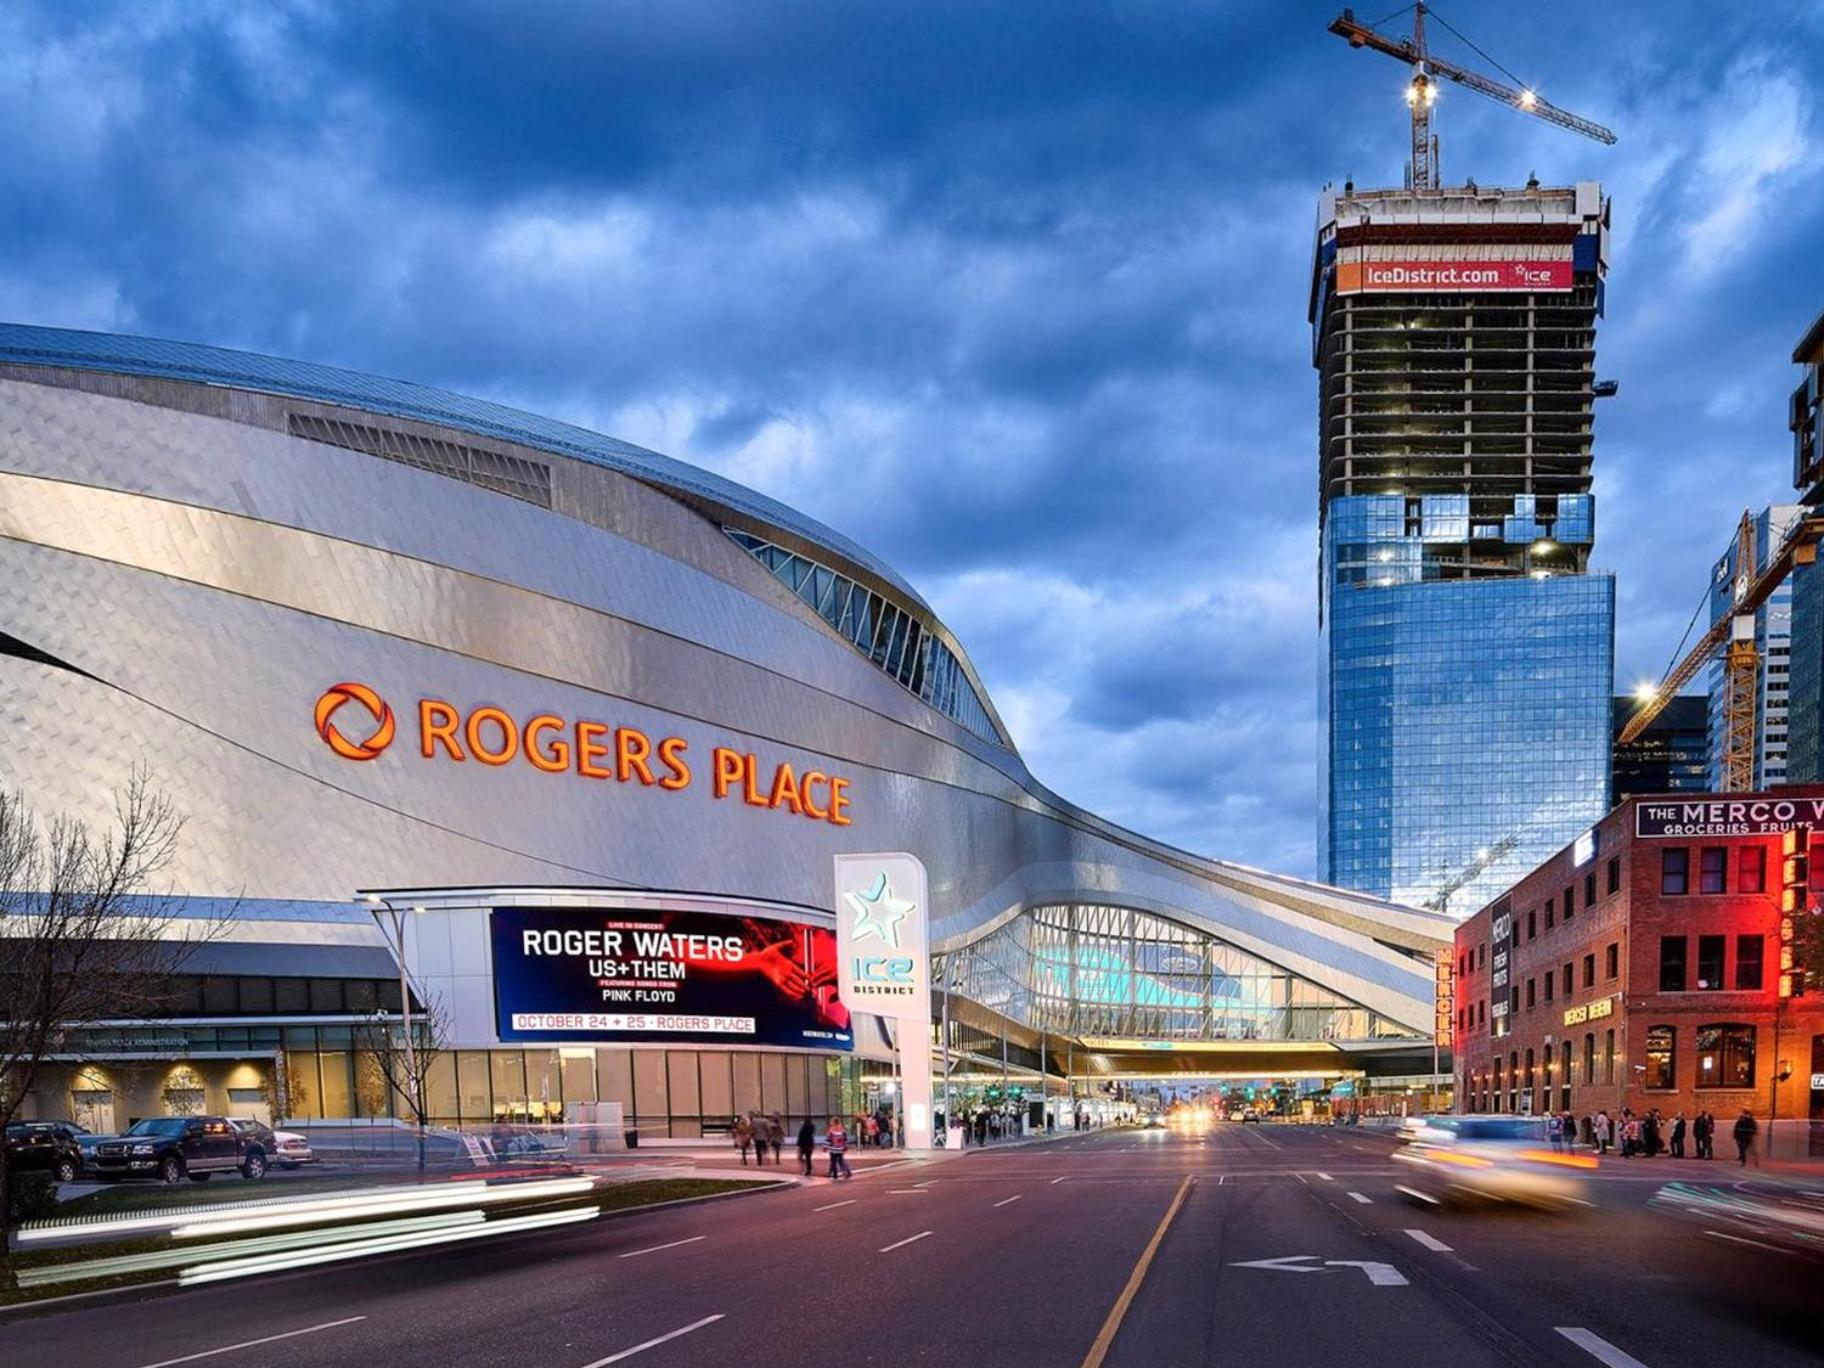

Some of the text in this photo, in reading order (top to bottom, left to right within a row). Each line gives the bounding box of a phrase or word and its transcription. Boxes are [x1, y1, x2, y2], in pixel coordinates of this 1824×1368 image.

[1368, 267, 1499, 284] IceDistrict.com
[418, 698, 852, 825] ROGERS PLACE
[1648, 808, 1676, 820] THE
[1683, 802, 1795, 823] MERCO
[1664, 823, 1750, 835] GROCERIES
[522, 930, 743, 962] ROGER WATERS
[589, 959, 686, 979] US+THEM
[602, 989, 676, 1002] PINK FLOYD
[853, 985, 914, 995] DISTRICT
[518, 1015, 583, 1028] OCTOBER
[589, 1016, 607, 1027] 24
[627, 1016, 646, 1028] 25
[657, 1017, 710, 1030] ROGERS
[714, 1018, 753, 1031] PLACE
